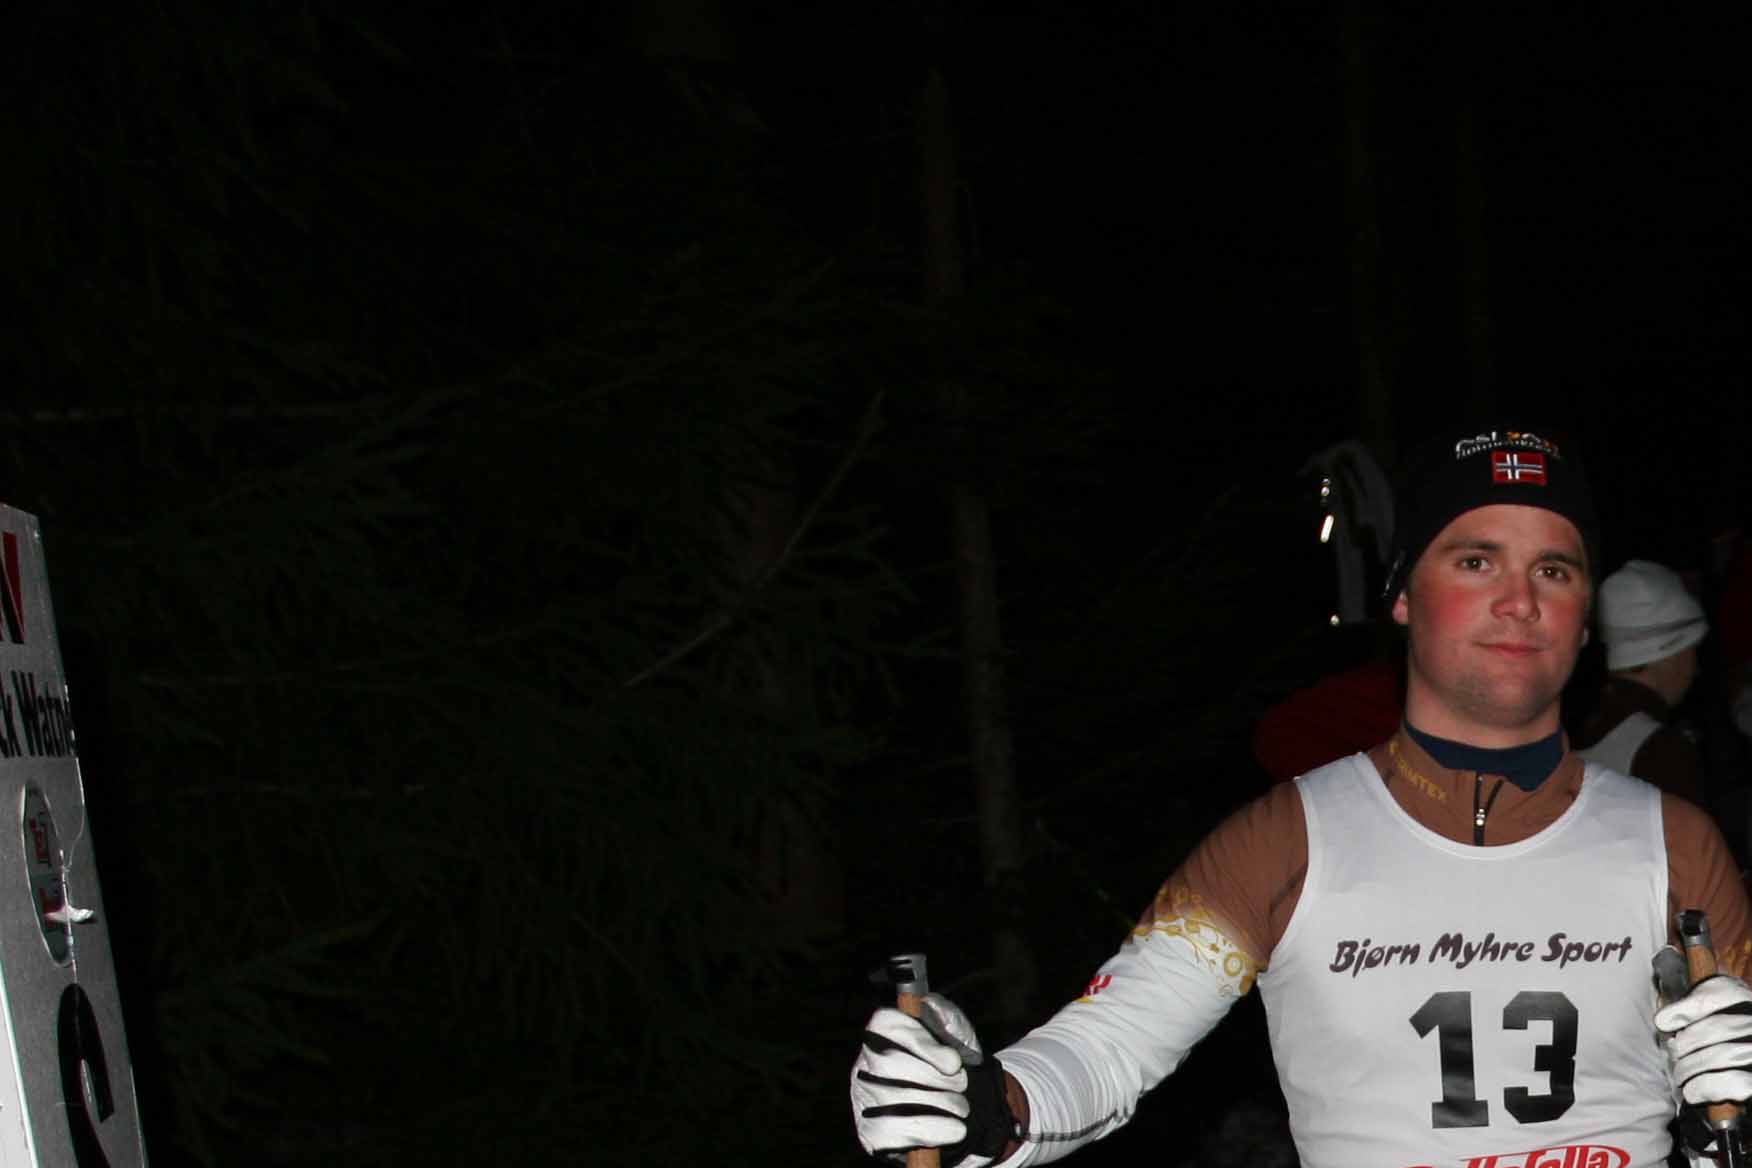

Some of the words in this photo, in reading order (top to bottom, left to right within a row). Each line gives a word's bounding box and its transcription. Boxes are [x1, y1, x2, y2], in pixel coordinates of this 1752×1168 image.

[1329, 938, 1420, 978] Bjørn
[1428, 932, 1534, 969] Myhre
[1541, 932, 1632, 969] Sport
[1409, 991, 1579, 1129] 13
